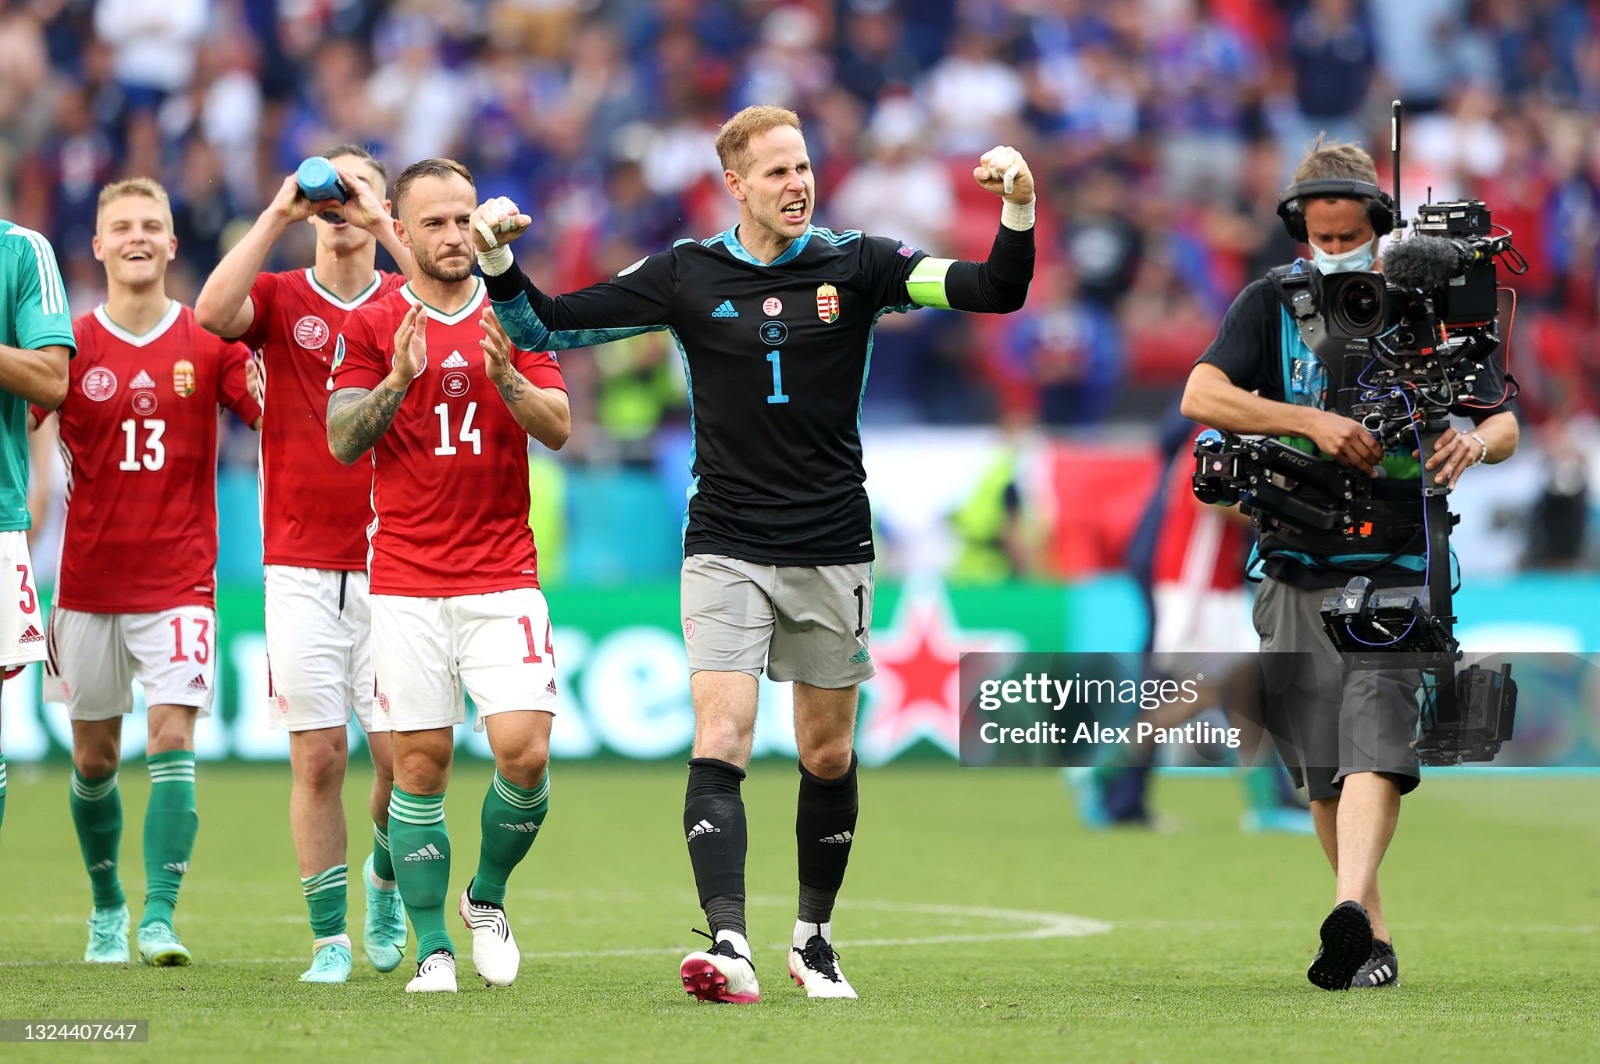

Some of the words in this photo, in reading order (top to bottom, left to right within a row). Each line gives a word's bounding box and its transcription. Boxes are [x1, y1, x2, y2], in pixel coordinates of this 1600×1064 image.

[766, 350, 789, 404] 1
[119, 418, 166, 472] 13
[434, 402, 482, 456] 14
[853, 584, 865, 638] 1
[18, 635, 45, 644] adidas
[169, 617, 209, 664] 13
[404, 854, 445, 862] adidas
